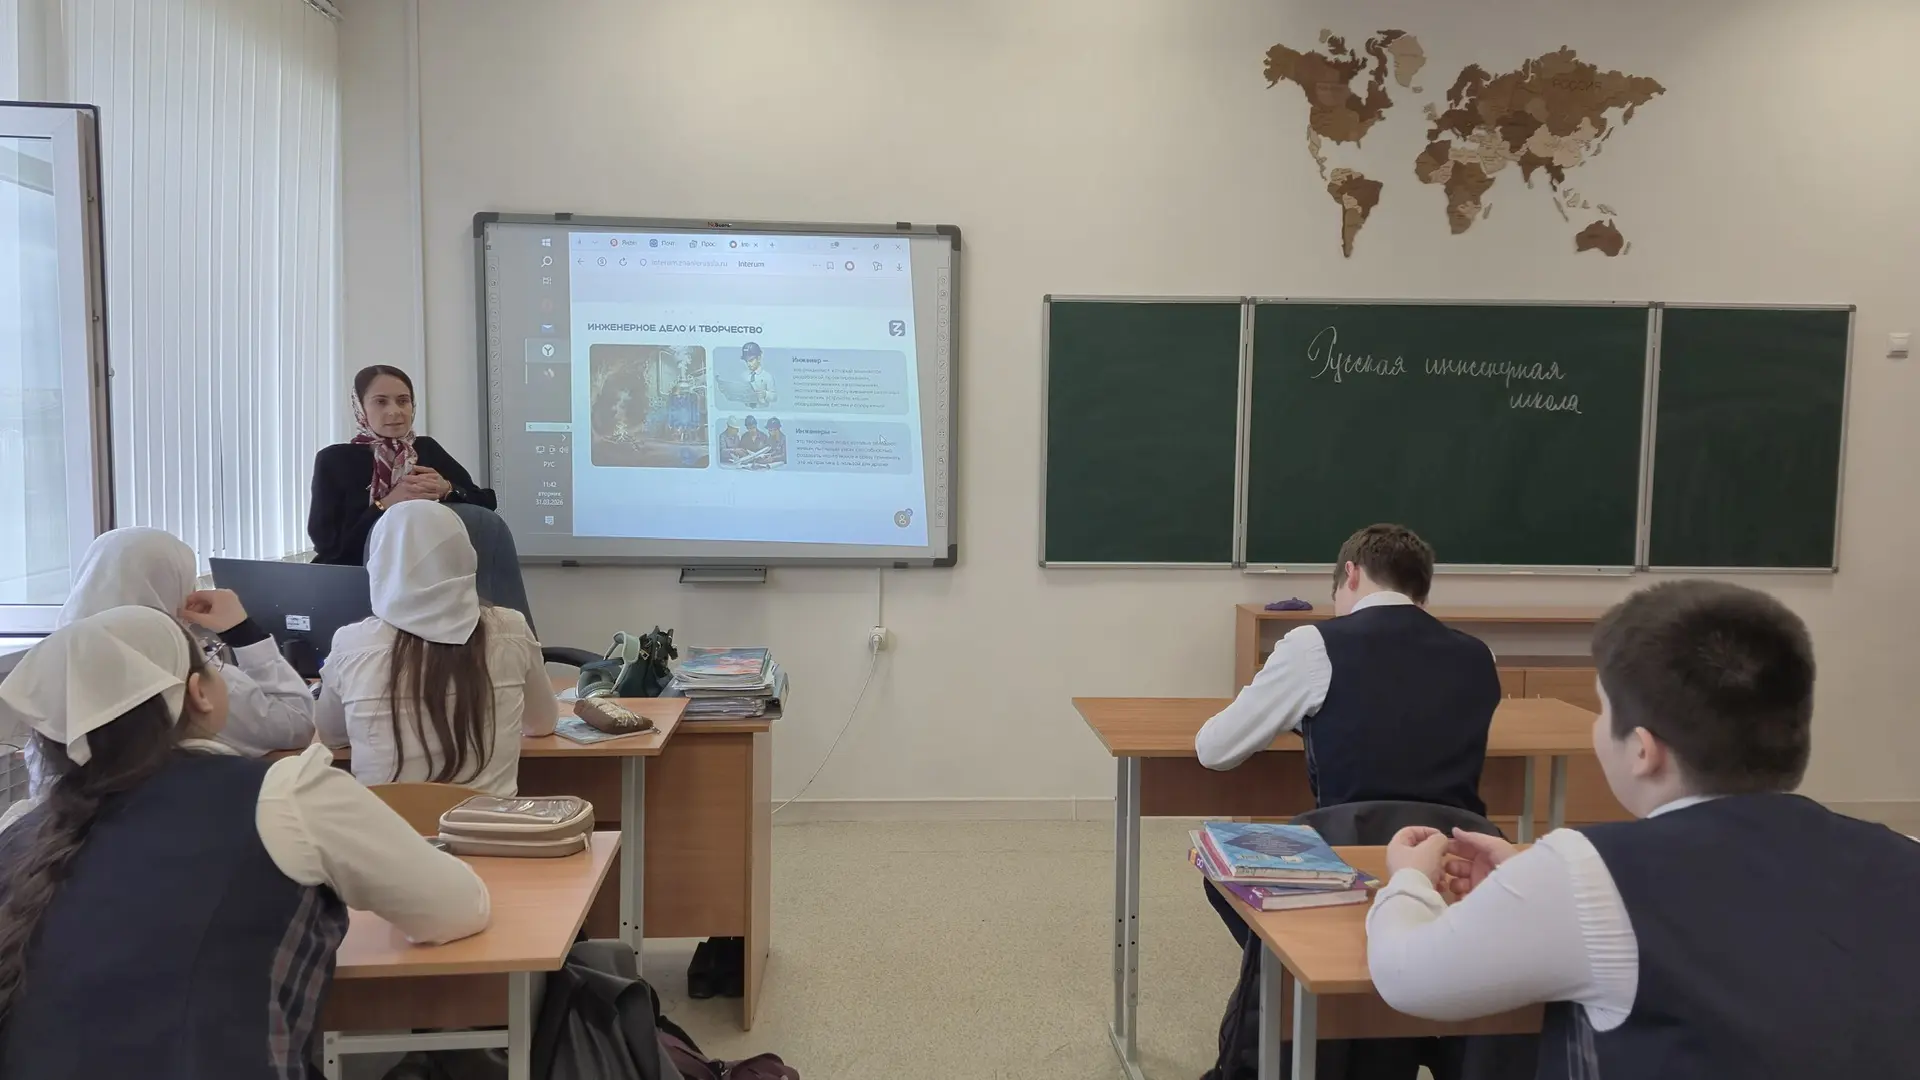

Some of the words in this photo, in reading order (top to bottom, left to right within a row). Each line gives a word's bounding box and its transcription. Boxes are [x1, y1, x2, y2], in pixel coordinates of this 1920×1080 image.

[1552, 79, 1602, 91] РОССИЯ
[738, 260, 764, 268] Interum
[587, 323, 657, 332] ИНЖЕНЕРНОЕ
[659, 324, 687, 333] ДЕЛО
[699, 325, 763, 334] ТВОРЧЕСТВО
[792, 356, 822, 364] Инженер
[1307, 326, 1407, 383] Русская
[1425, 357, 1567, 388] инженерная
[1510, 392, 1583, 414] школа
[795, 428, 831, 436] Инженеры
[543, 460, 556, 468] РУС
[535, 498, 564, 506] 31.03.2026
